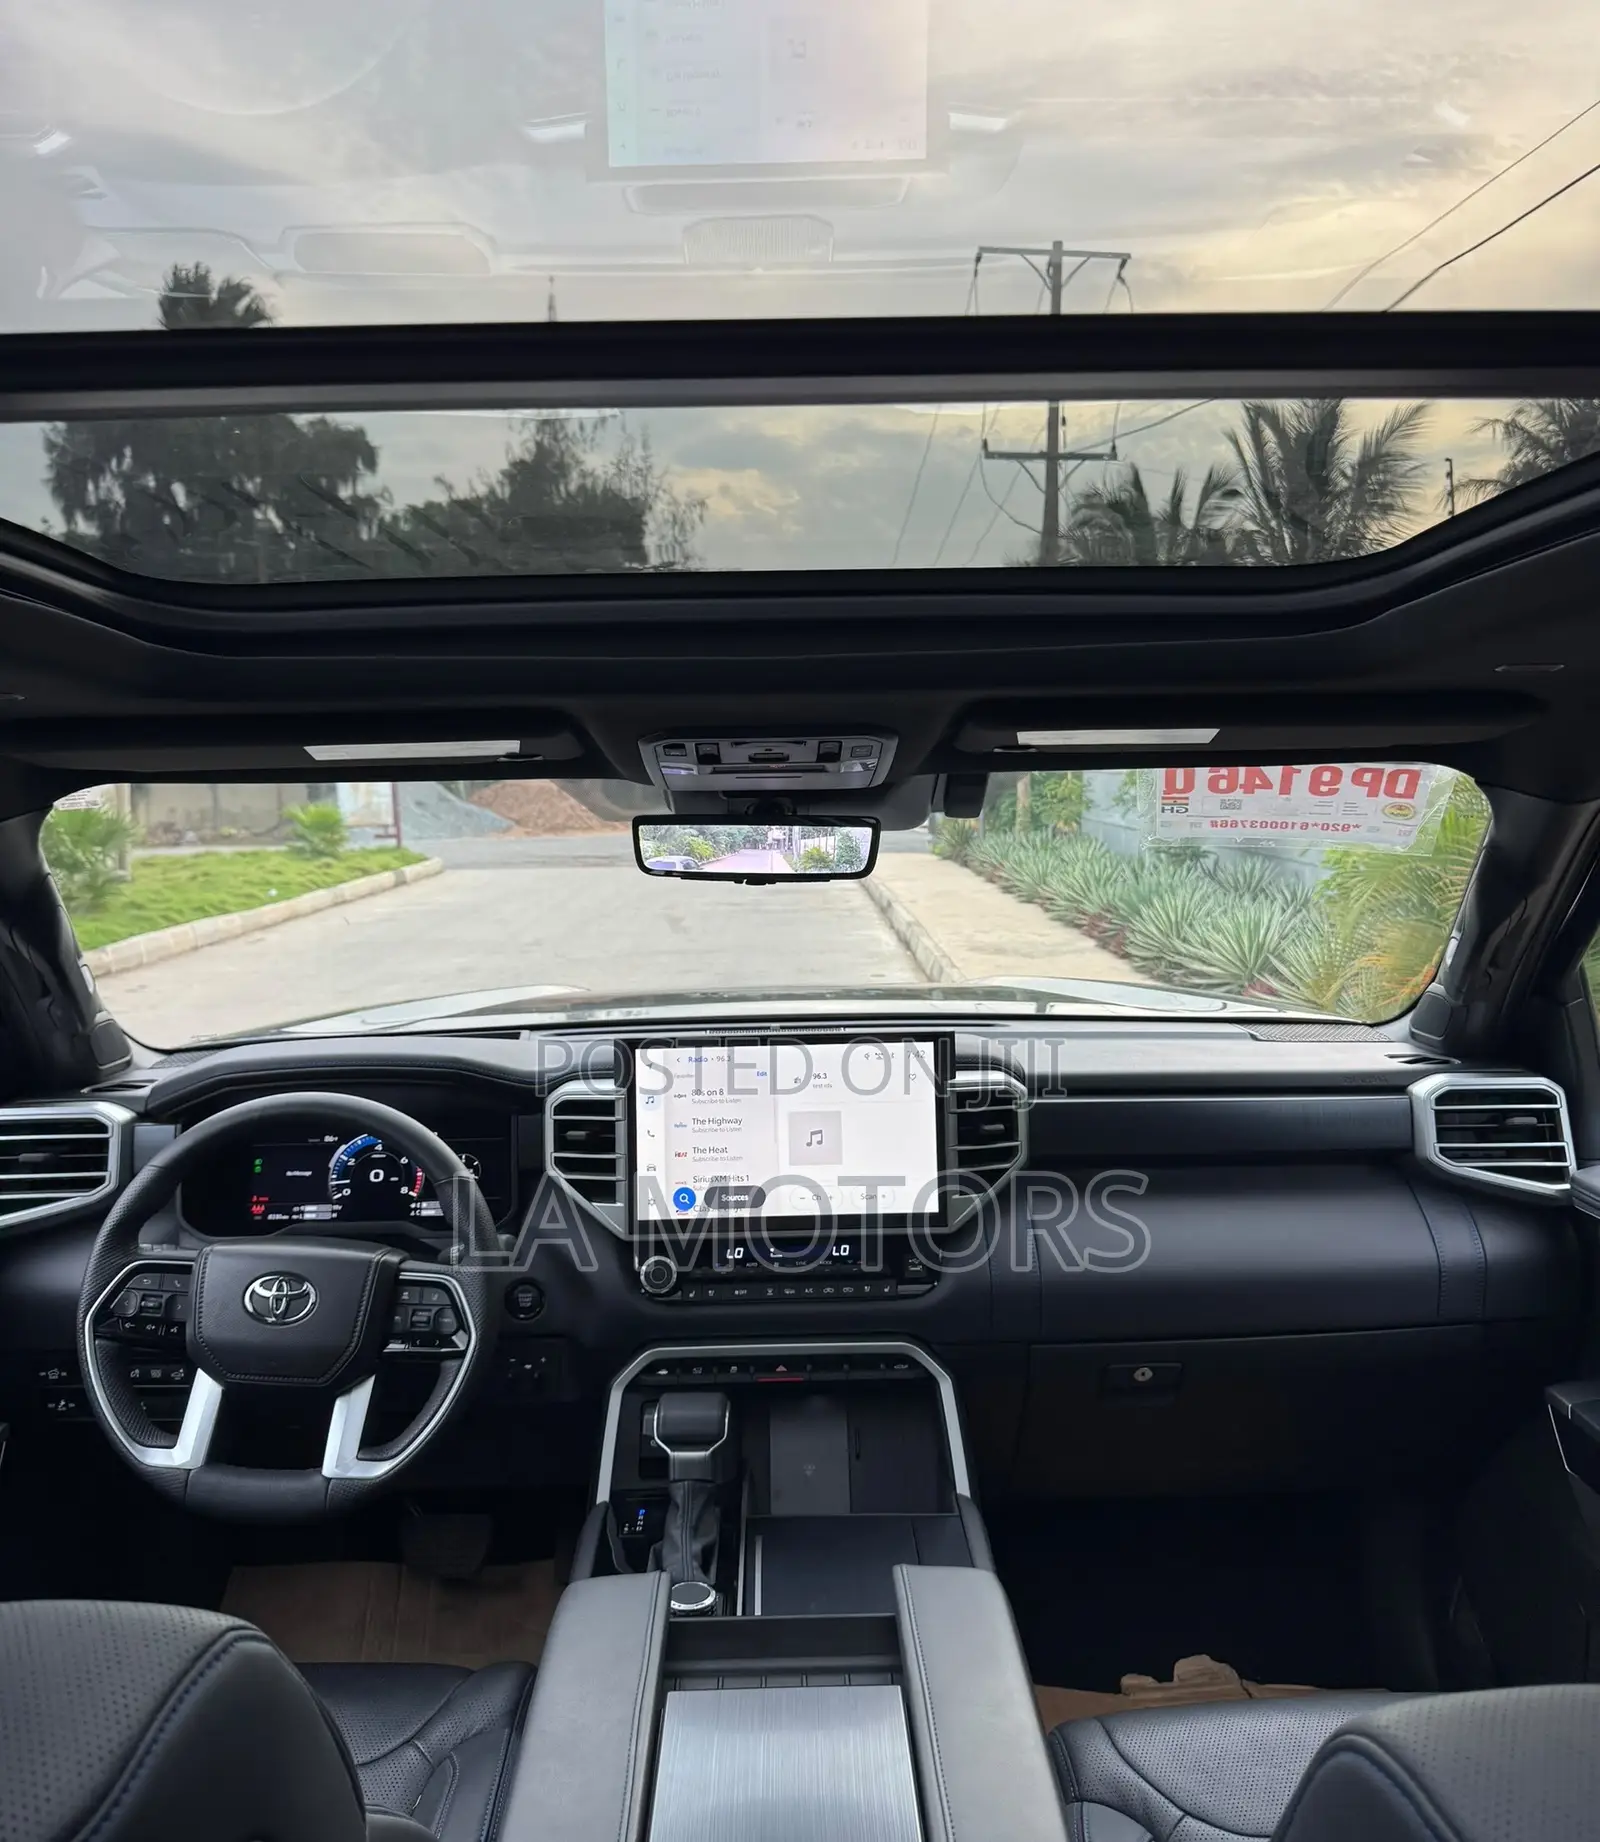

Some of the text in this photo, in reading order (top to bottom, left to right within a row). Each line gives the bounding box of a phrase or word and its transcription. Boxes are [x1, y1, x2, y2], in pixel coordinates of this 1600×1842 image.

[719, 1088, 725, 1096] 8
[692, 1117, 707, 1126] The
[707, 1117, 743, 1127] Highway
[692, 1146, 728, 1154] The Heat
[347, 1158, 356, 1166] 2
[400, 1156, 409, 1164] 6
[369, 1169, 385, 1182] 0
[692, 1175, 727, 1184] SiriusXM
[341, 1188, 351, 1196] 0
[400, 1186, 409, 1194] 8
[721, 1194, 749, 1202] Sources
